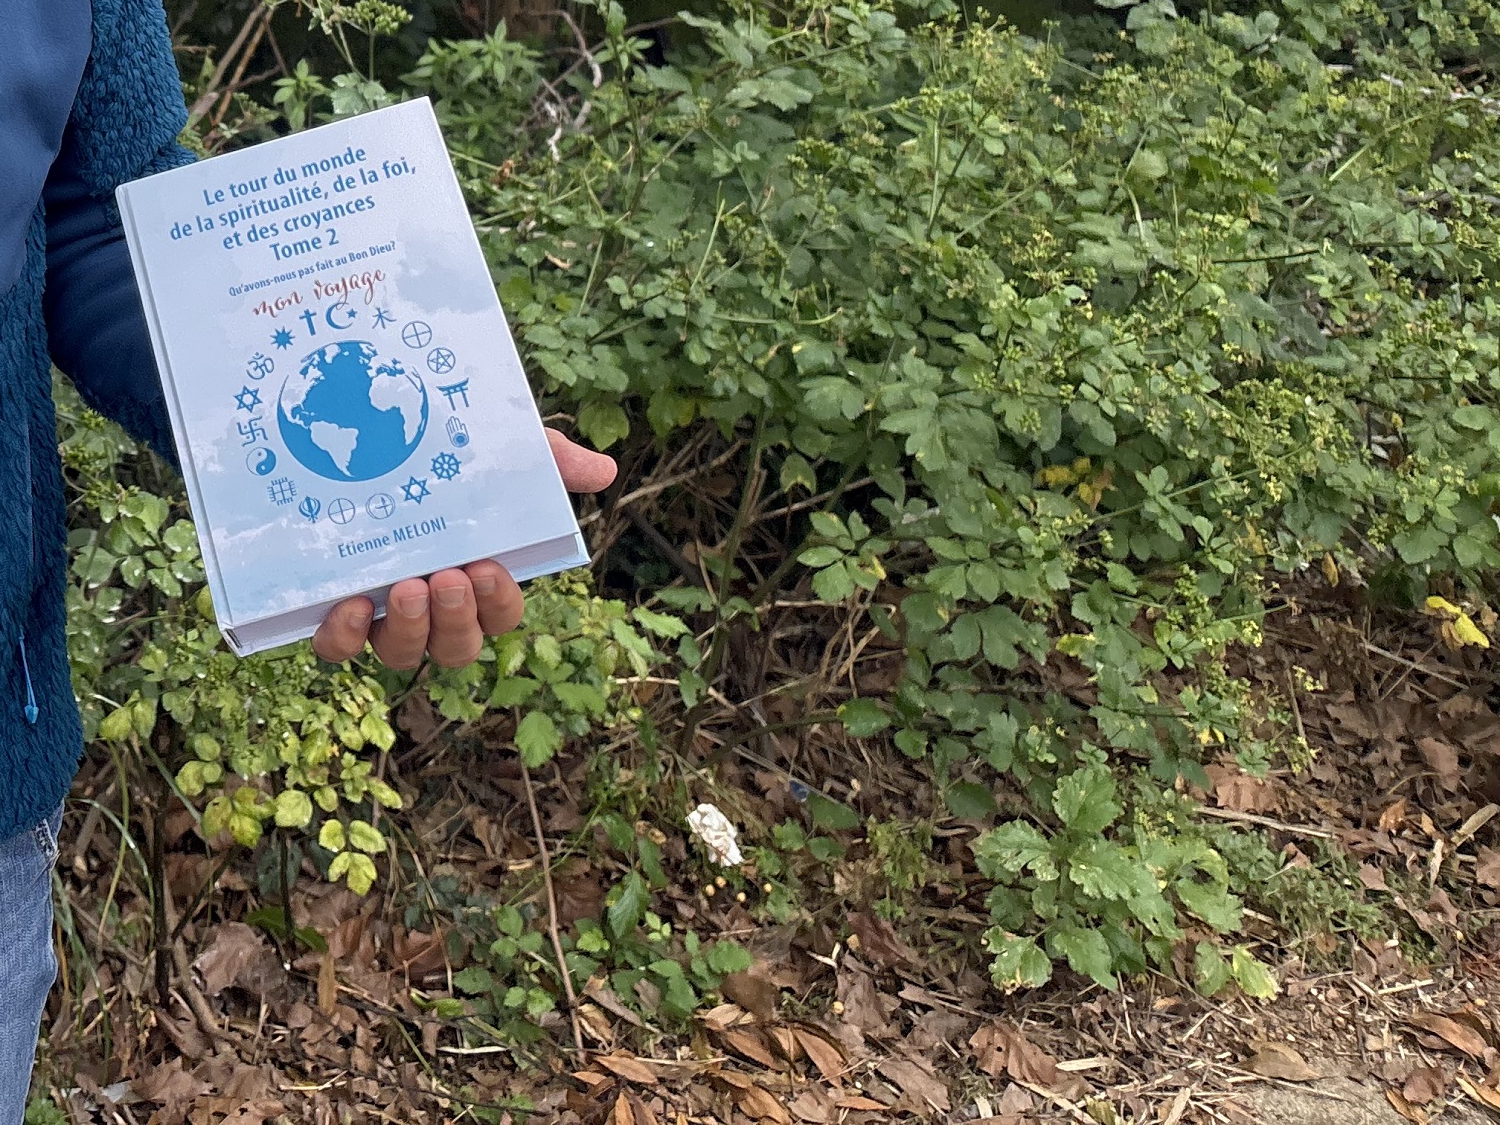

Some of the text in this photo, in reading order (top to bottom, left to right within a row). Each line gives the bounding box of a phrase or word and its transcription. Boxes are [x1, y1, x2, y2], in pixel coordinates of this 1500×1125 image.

[170, 156, 416, 241] de la spiritualité, de la foi,
[203, 146, 366, 206] Le tour du monde
[223, 195, 376, 250] et des croyances
[269, 228, 340, 261] Tome 2
[228, 241, 397, 297] Qu'avons-nous pas fait au Bon Dieu?
[252, 269, 386, 319] mon voyage
[338, 516, 447, 558] Etienne MELONI
